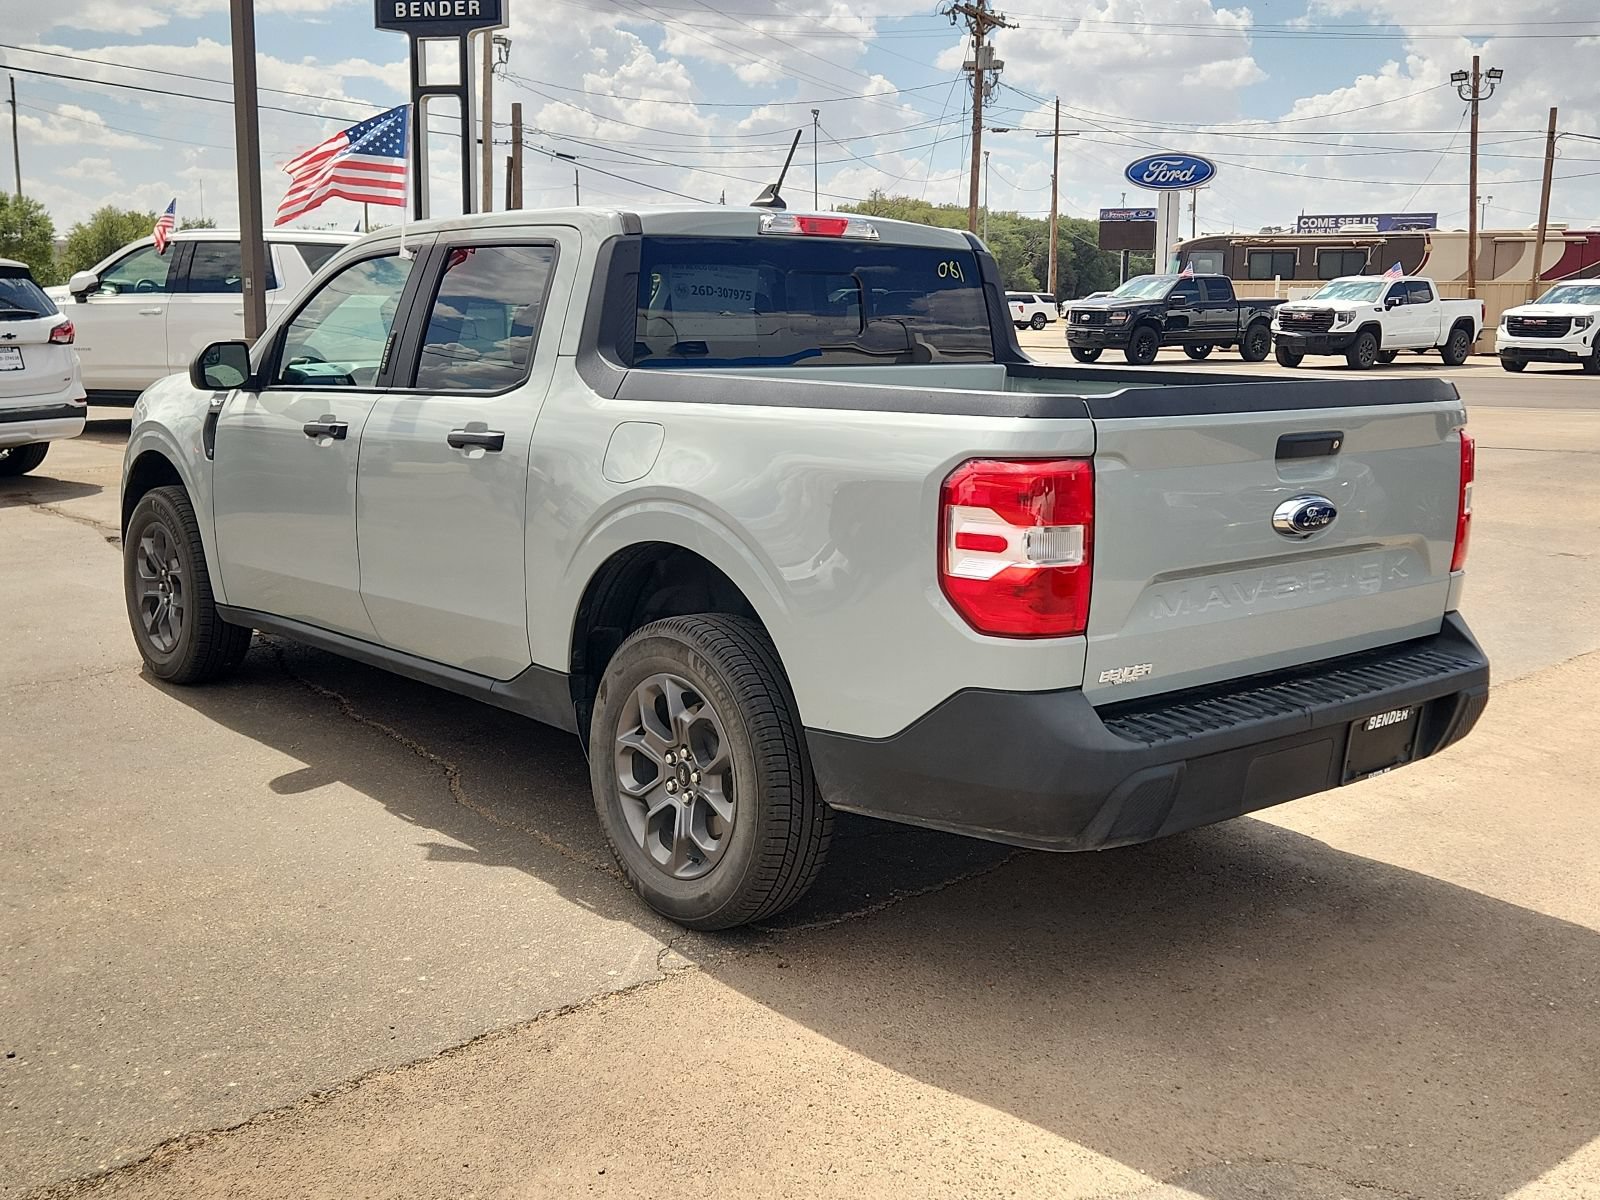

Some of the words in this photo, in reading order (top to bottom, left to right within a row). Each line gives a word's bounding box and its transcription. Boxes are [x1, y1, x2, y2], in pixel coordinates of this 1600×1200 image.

[395, 1, 480, 17] BENDER
[1143, 160, 1197, 182] Ford
[1300, 218, 1336, 228] COME
[938, 261, 964, 283] 081
[690, 285, 752, 301] 26D-307975
[1303, 507, 1331, 527] Ford
[1150, 556, 1409, 620] MAVERICK
[1099, 663, 1153, 683] BENDER
[1367, 709, 1409, 731] BENDER
